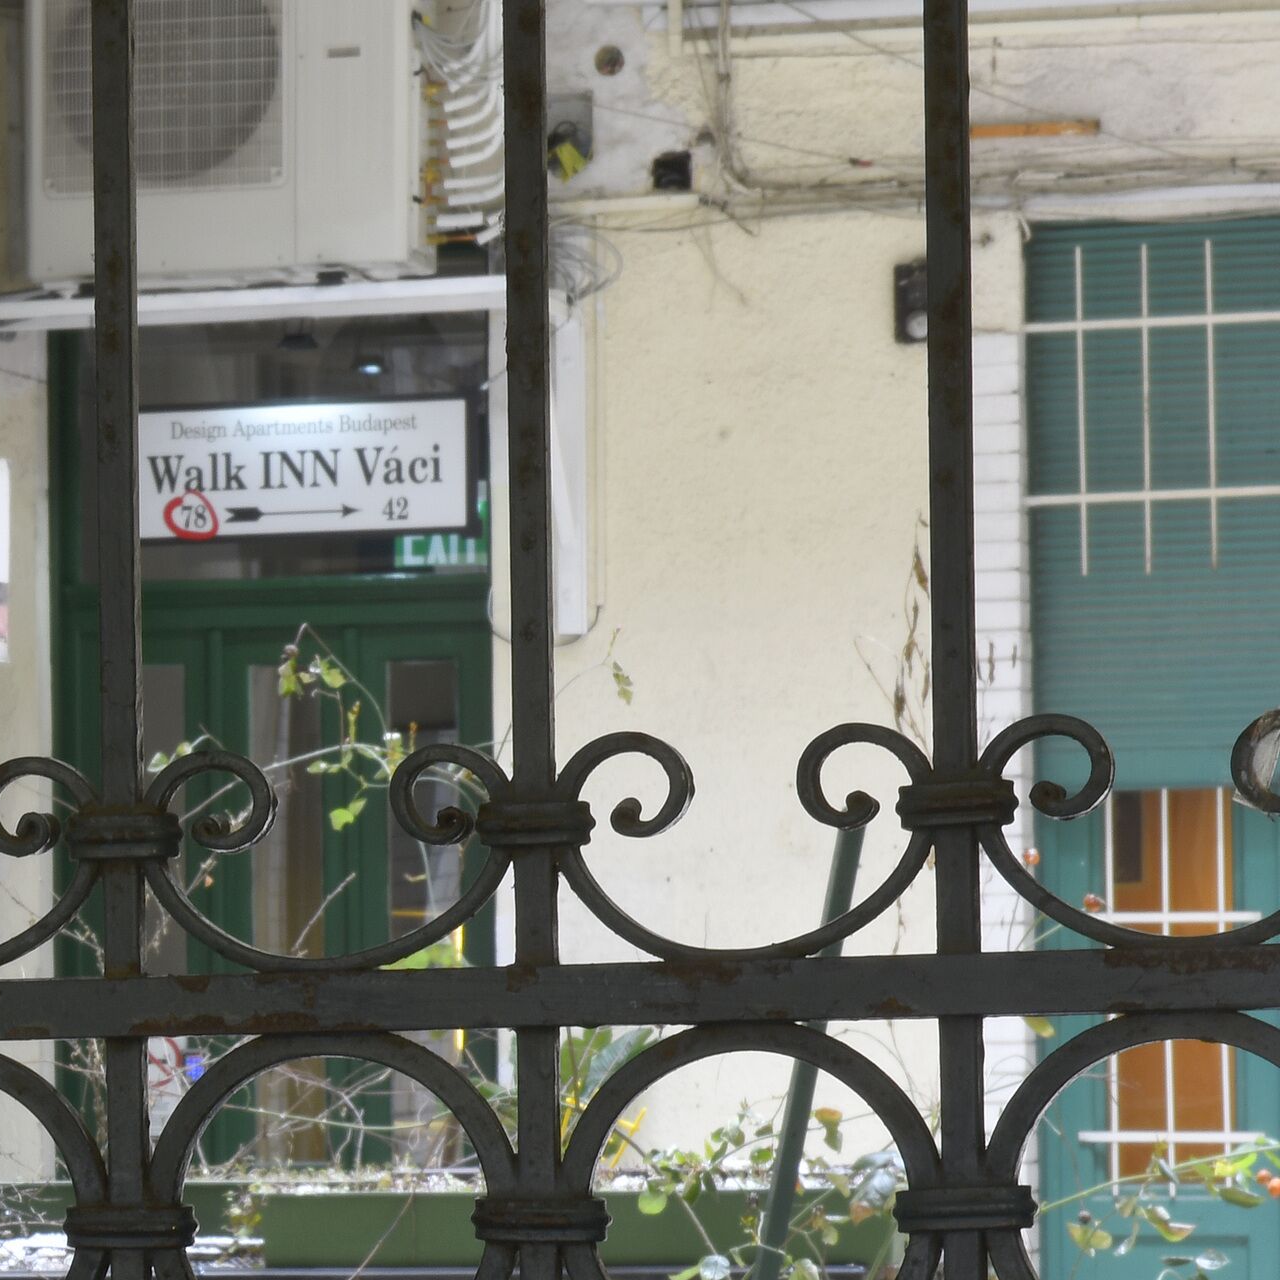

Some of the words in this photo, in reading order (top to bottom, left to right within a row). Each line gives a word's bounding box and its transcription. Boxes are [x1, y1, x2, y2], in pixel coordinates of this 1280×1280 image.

[170, 419, 227, 442] Design
[232, 419, 333, 442] Apartments
[339, 414, 418, 435] Budapest
[147, 451, 247, 495] Walk
[259, 448, 341, 490] INN
[354, 443, 443, 487] Váci
[180, 505, 208, 529] 78
[382, 497, 409, 521] 42
